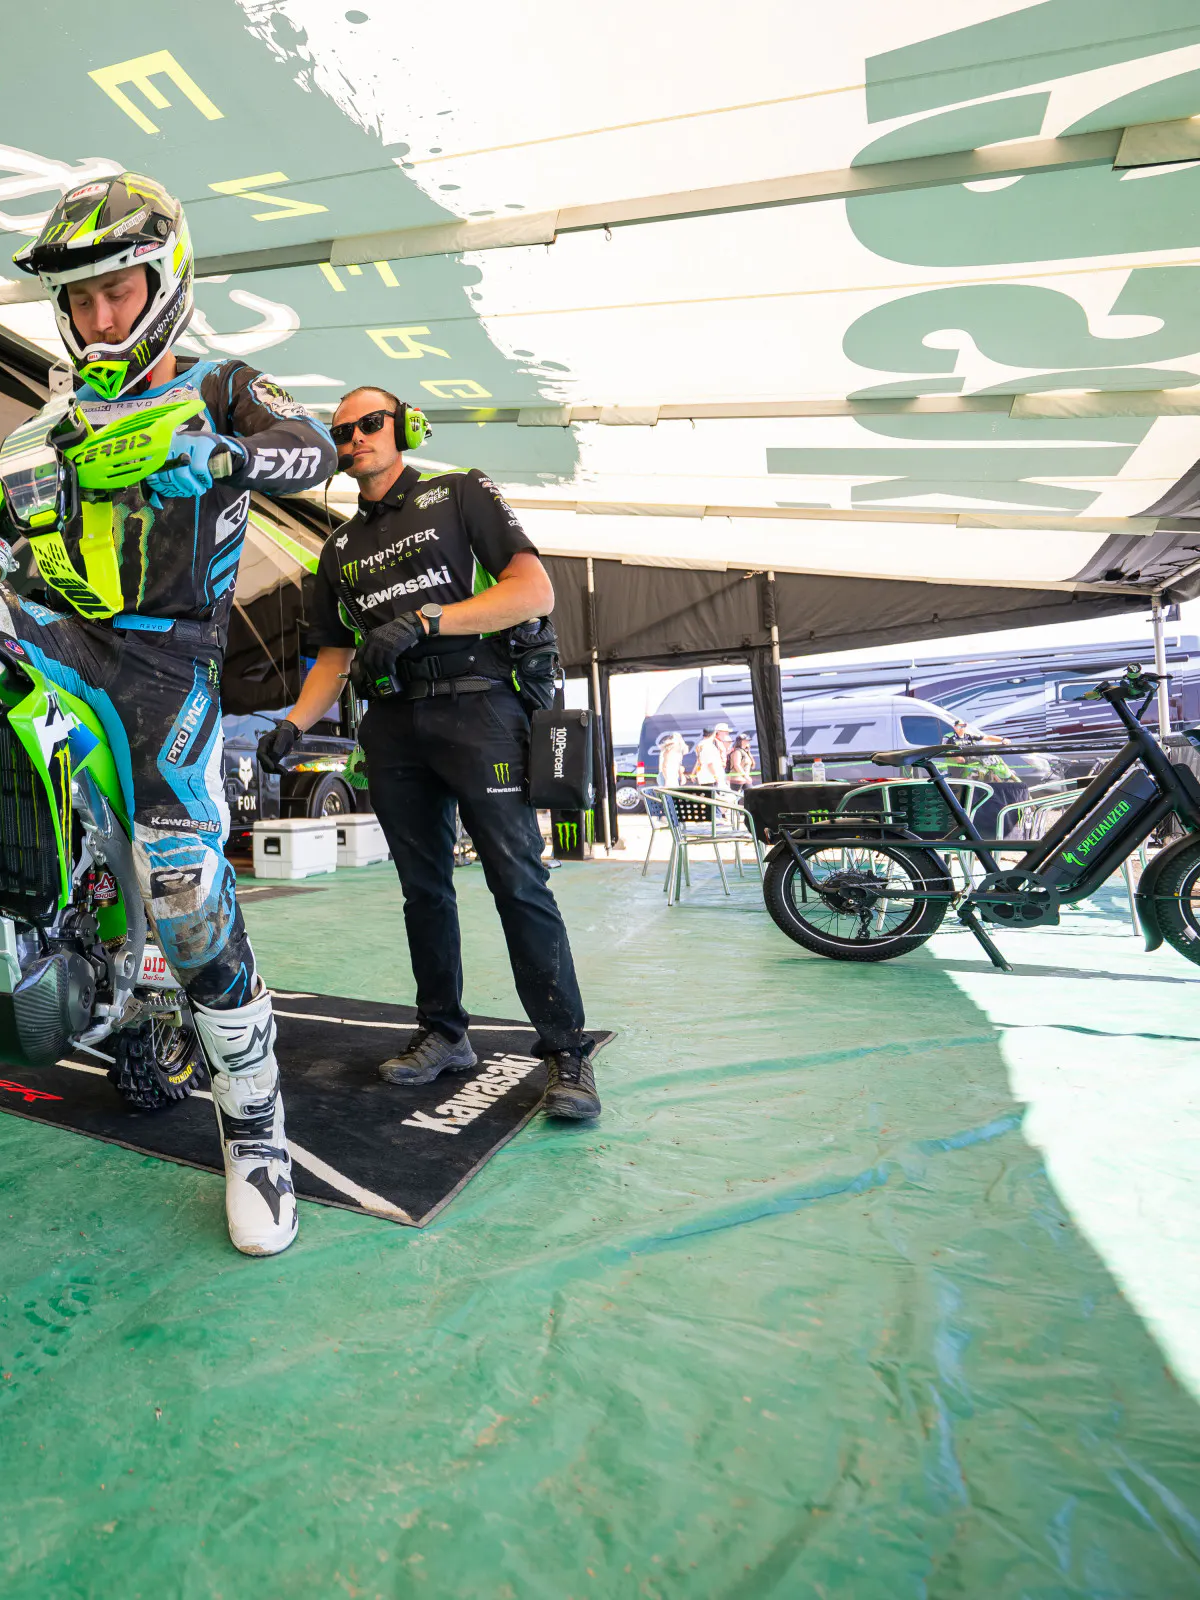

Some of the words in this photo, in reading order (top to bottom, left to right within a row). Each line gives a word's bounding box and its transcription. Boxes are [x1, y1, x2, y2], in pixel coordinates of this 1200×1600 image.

[116, 400, 153, 409] REVO
[247, 447, 322, 480] FXR
[360, 528, 440, 568] MONSTER
[369, 547, 422, 574] ENERGY
[166, 729, 189, 764] PRO
[553, 726, 568, 779] 100Percent
[237, 795, 257, 811] FOX
[151, 816, 221, 834] Kawasaki
[1077, 799, 1132, 857] SPECIALIZED
[143, 956, 167, 973] DID
[401, 1052, 545, 1135] Kawasaki
